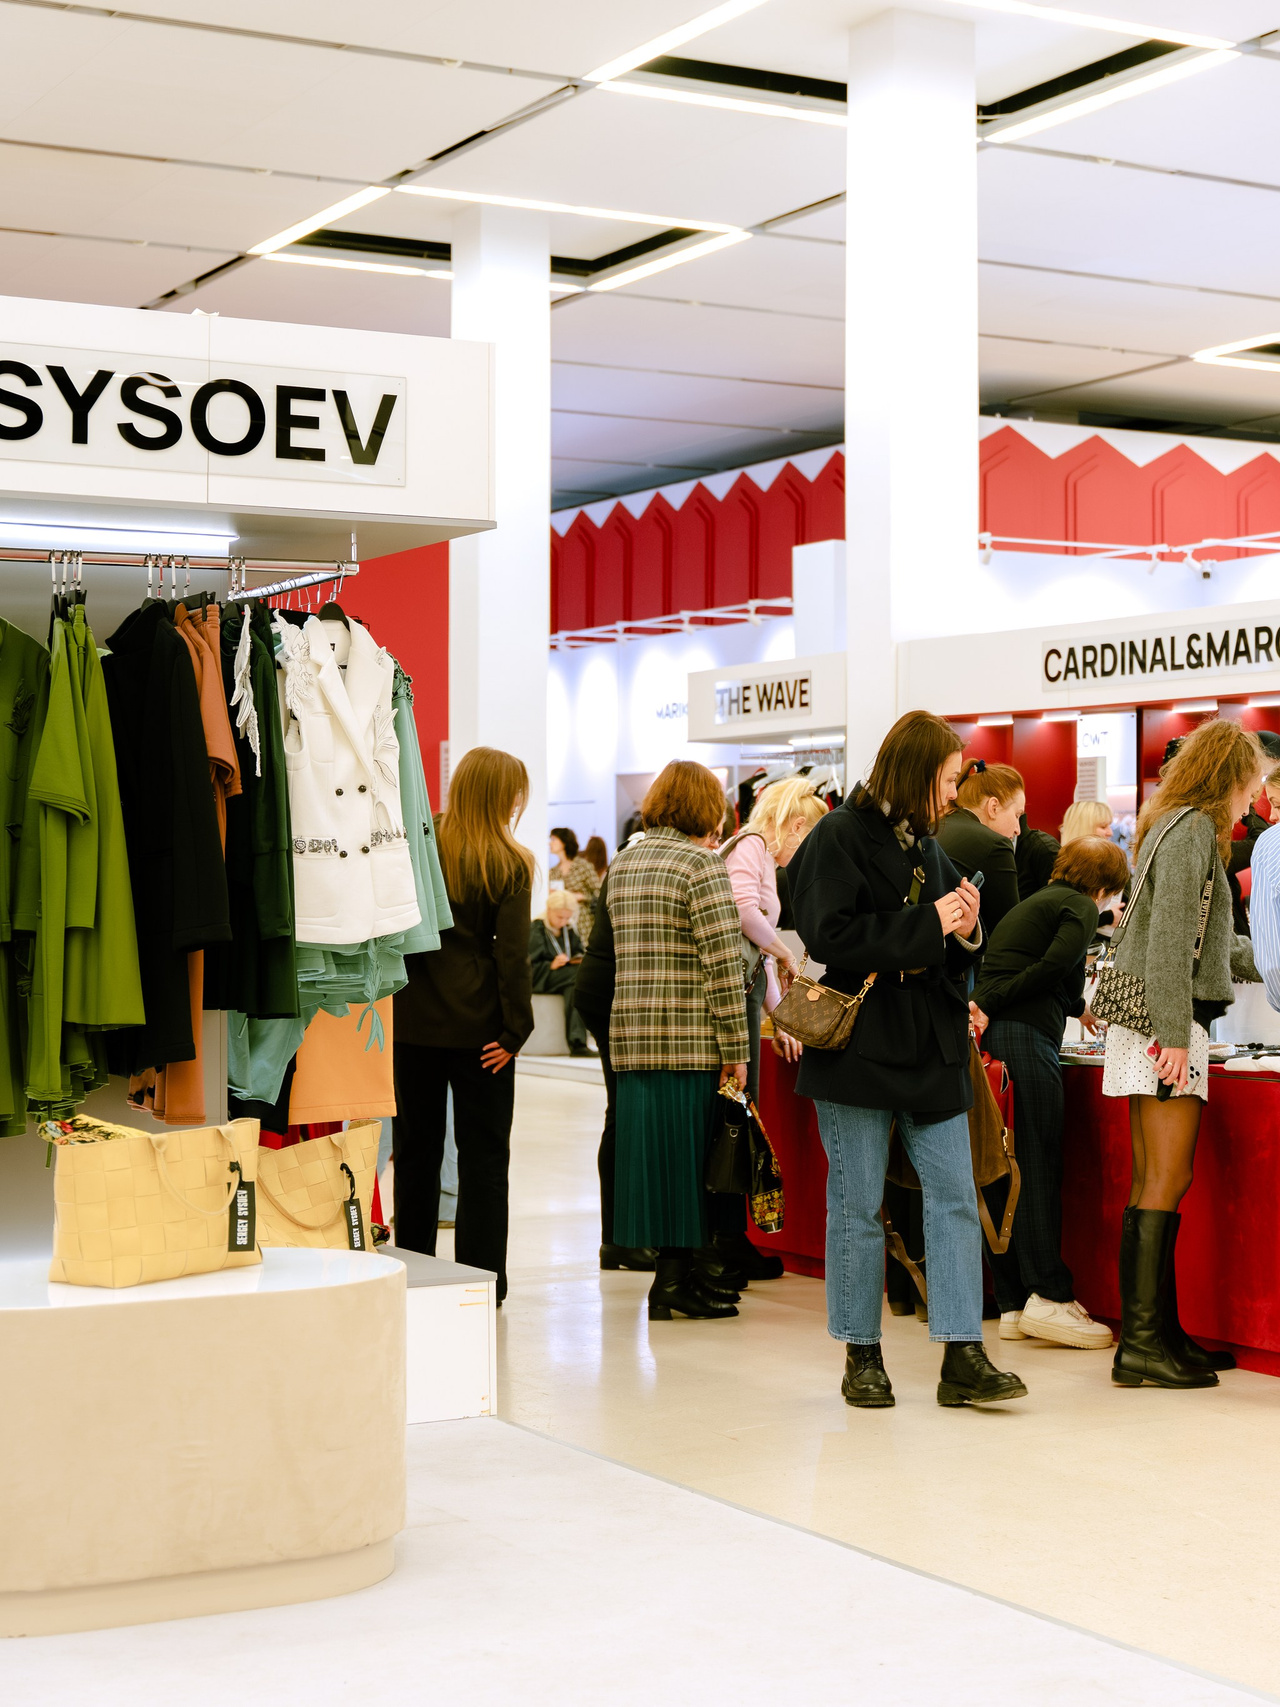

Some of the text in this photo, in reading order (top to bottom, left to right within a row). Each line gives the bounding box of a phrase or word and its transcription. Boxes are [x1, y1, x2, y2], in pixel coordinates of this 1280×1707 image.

[0, 360, 398, 466] SYSOEV
[716, 678, 810, 717] THE WAVE
[1197, 880, 1214, 938] CHRISTIAN DIOR
[236, 1189, 249, 1246] SERGEY SYSOEV
